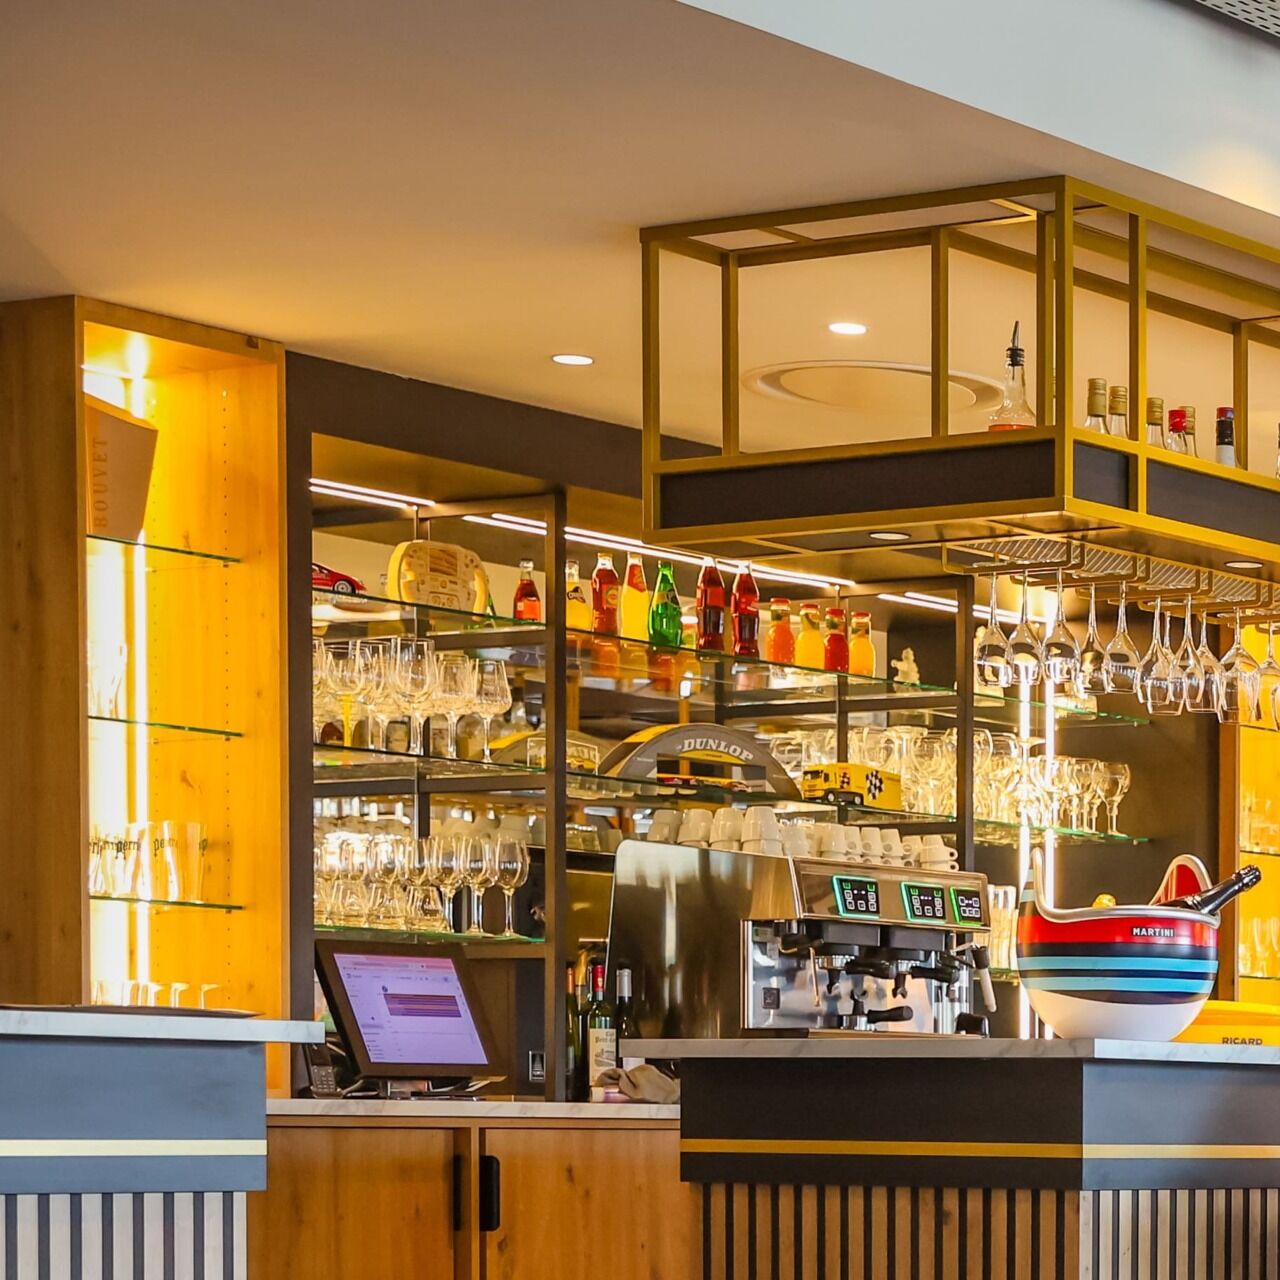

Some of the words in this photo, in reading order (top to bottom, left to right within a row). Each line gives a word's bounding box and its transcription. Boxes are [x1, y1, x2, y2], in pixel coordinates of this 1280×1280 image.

[92, 438, 109, 528] BOUVET
[682, 738, 753, 761] DUNLOP
[1132, 927, 1174, 937] MARTINI
[1222, 1037, 1263, 1046] RICARD
